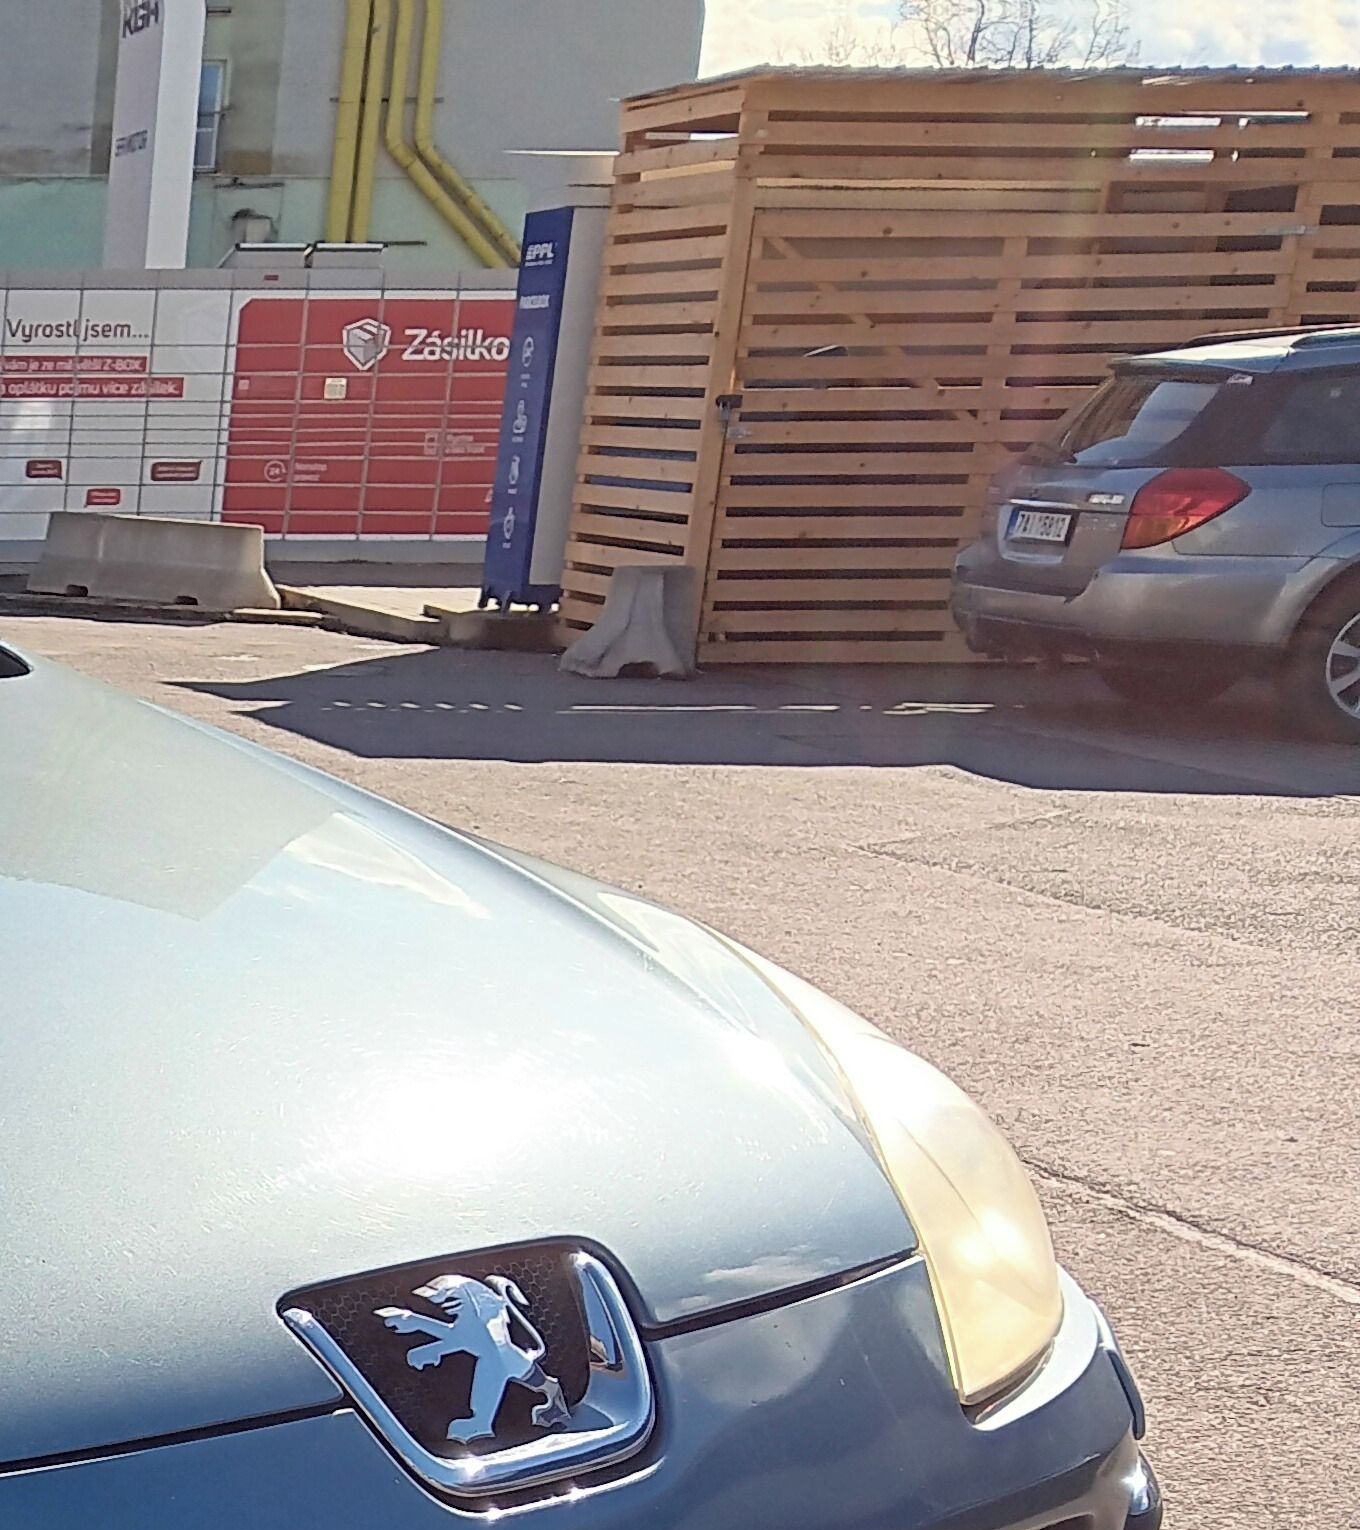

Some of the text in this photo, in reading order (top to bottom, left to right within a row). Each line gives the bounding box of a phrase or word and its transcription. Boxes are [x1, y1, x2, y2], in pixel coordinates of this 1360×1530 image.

[7, 319, 150, 343] Vyrostl jsem...
[401, 328, 511, 361] Zásilko
